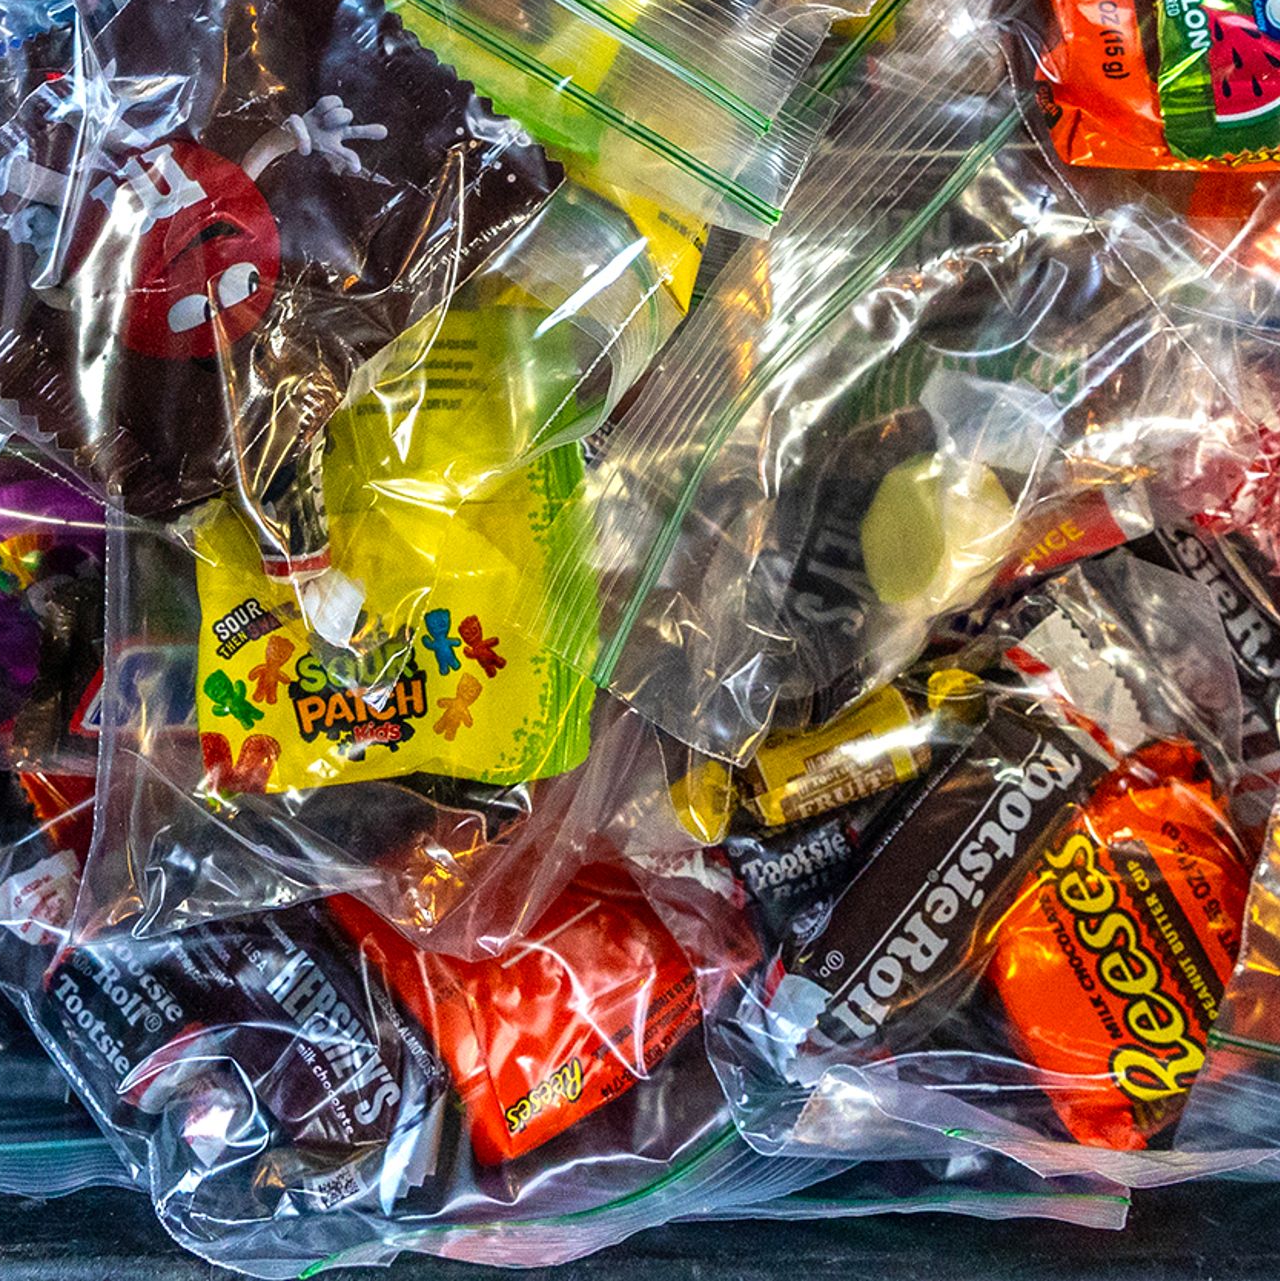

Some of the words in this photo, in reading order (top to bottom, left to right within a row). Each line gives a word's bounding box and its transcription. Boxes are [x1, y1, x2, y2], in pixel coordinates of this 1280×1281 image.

[1099, 2, 1118, 29] OZ
[1111, 55, 1130, 80] g)
[213, 598, 266, 642] SOUR
[217, 630, 250, 660] THEN
[353, 722, 403, 742] Kids
[739, 828, 849, 892] Tootsie
[929, 737, 1088, 928] Tootsie
[1124, 858, 1155, 898] CUP
[1050, 829, 1209, 1104] Reese's
[1146, 898, 1191, 966] BUTTER
[830, 907, 941, 1042] Roll
[1181, 962, 1222, 1022] PEANUT
[56, 975, 132, 1078] Tootsie
[295, 1041, 320, 1074] milk
[312, 1070, 357, 1138] chocolate
[505, 1058, 585, 1135] Reese's
